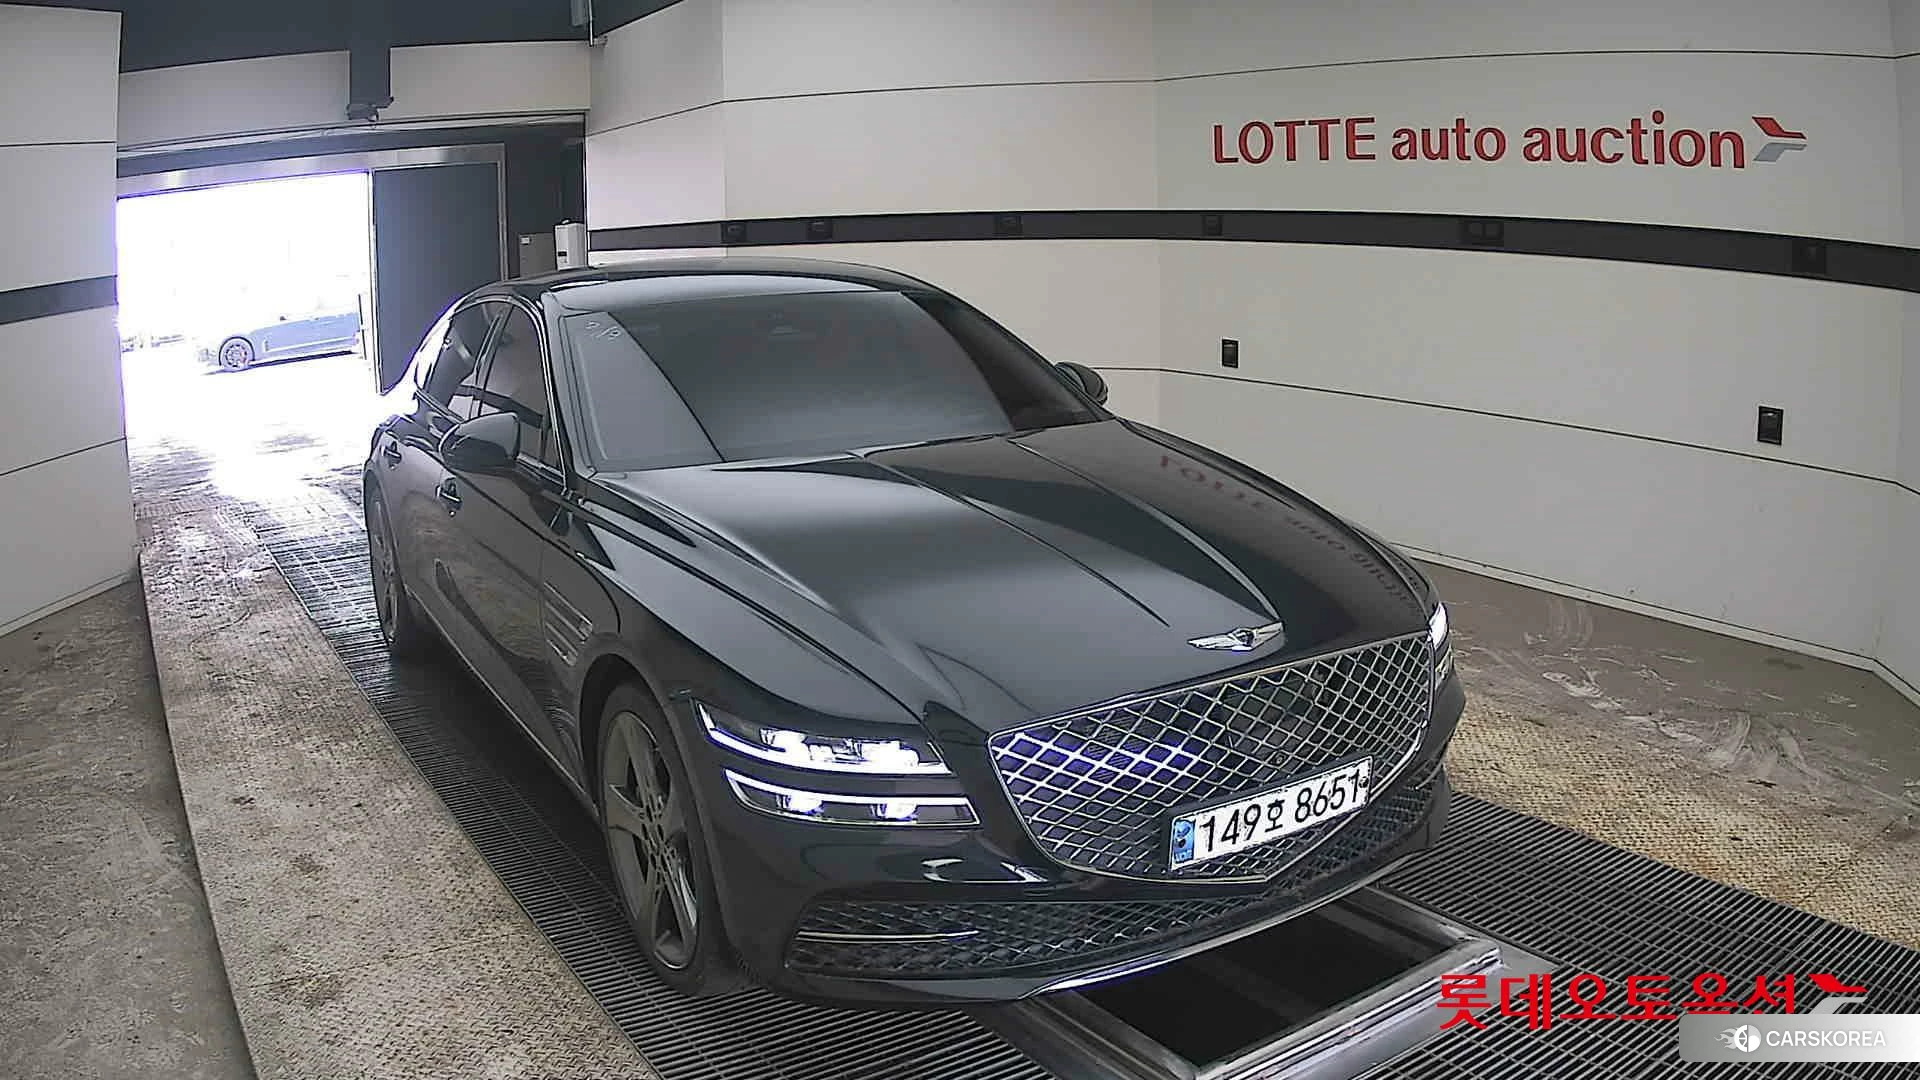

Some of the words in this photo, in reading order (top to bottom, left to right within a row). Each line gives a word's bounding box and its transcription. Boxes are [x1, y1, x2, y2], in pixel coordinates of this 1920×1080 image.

[1212, 116, 1376, 164] LOTTE
[1391, 117, 1507, 161] auto
[1522, 110, 1746, 169] auction
[1199, 798, 1286, 853] 149호
[1294, 768, 1361, 824] 8651
